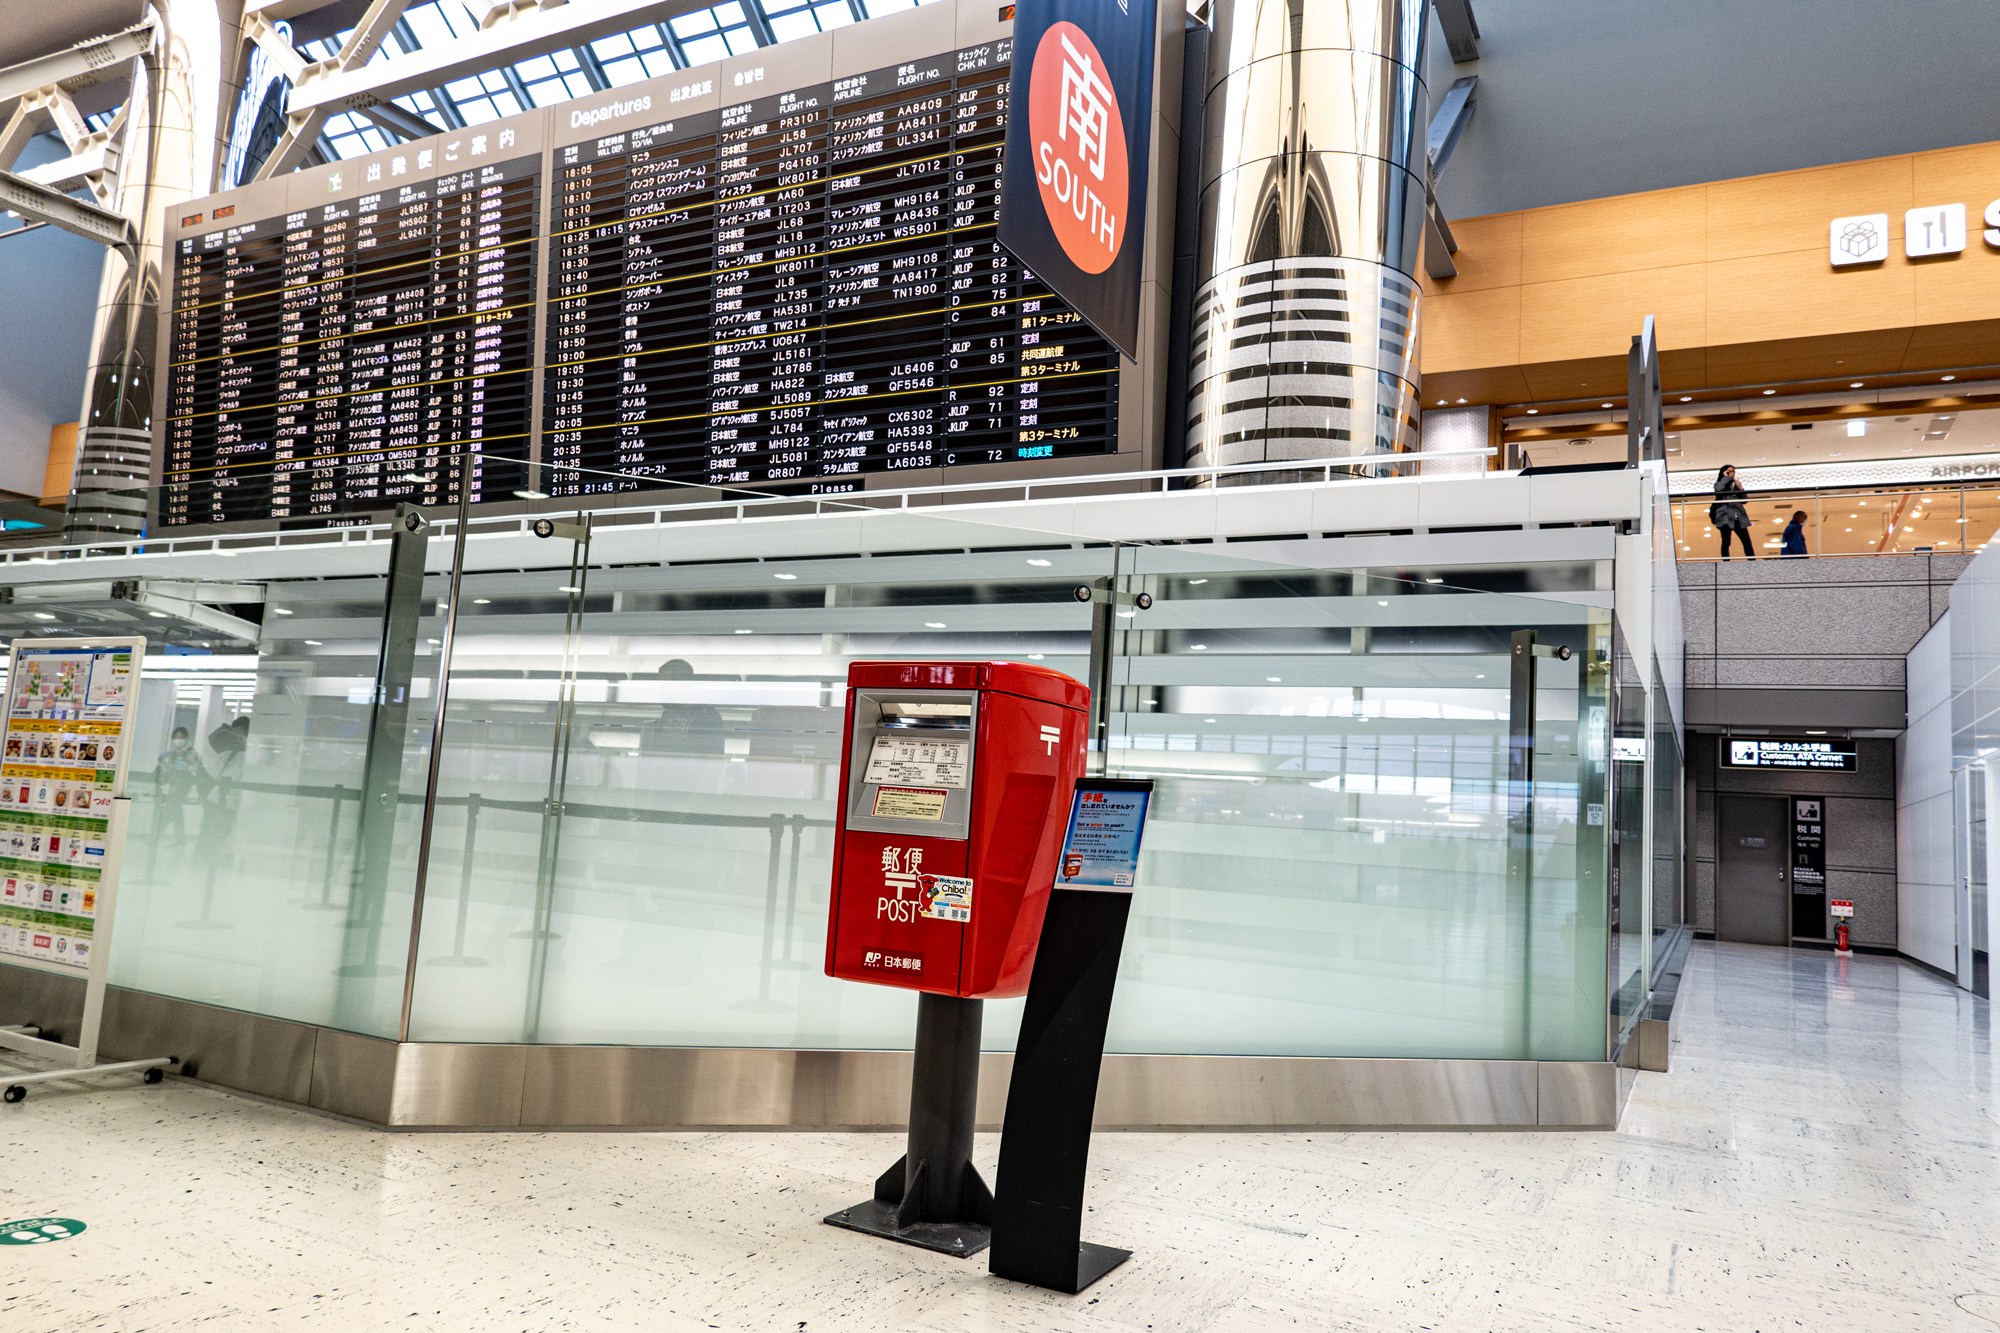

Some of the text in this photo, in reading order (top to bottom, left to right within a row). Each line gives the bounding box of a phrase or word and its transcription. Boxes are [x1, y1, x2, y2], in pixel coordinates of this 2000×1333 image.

[957, 46, 990, 62] チェックイン
[957, 57, 987, 72] CHK IN
[996, 51, 1012, 63] GAT
[897, 68, 941, 86] FLIGHT NO.
[898, 64, 915, 76] 便名
[834, 75, 867, 92] 航空会社
[834, 87, 862, 101] AIRLINE
[780, 93, 796, 105] 便名
[780, 98, 818, 114] FLIGHT NO.
[1059, 32, 1112, 181] 南
[571, 96, 651, 128] Departures
[722, 104, 752, 119] 航空会社
[722, 114, 748, 128] AIRLINE
[564, 98, 942, 192] 18:10 サンフランシスコ JL58 AA8409
[565, 112, 819, 179] 18:05 フィリピン航空 PR3101
[632, 137, 653, 149] TO/VIA
[779, 114, 940, 158] JL707 AA8411
[367, 128, 515, 182] 出発便ご案内
[564, 155, 578, 165] TIME
[597, 145, 624, 157] WILL DEP.
[778, 129, 940, 172] PG4160 UL3341
[461, 180, 474, 189] GATE
[480, 172, 504, 184] REMARKS
[778, 170, 819, 187] UK8012
[628, 160, 941, 232] ダラスフォートワース アメリカン航空 AA60 JL7012
[1038, 141, 1115, 253] SOUTH
[399, 203, 429, 217] JL9567
[323, 215, 428, 245] NX861 ANA NH5902
[398, 228, 426, 241] JL9241
[561, 191, 940, 271] 18:30 日本航空 JL68 MH9164
[562, 201, 811, 257] 18:25 タイガーエア台湾 IT203
[776, 206, 939, 245] JL18 AA8436
[717, 222, 937, 269] マレーシア航空 MH9112 WS5901
[322, 257, 344, 268] HB531
[775, 253, 938, 289] JL8 MH9108
[626, 259, 814, 300] シンガポール UK8011
[320, 292, 343, 303] VJ935
[394, 301, 424, 313] MH9114
[559, 268, 938, 336] 18:50 JL735 AA8417
[714, 284, 937, 326] ハワイアン航空 HA5381 TN1900
[318, 313, 424, 338] CI105 JL5175
[558, 289, 1007, 362] 19:00 ティーウェイ航空 TW214 75
[772, 301, 1041, 347] UO647 定刻
[318, 338, 422, 362] JL759 AA8422
[557, 311, 1082, 390] 19:30 JL5161 第1ターミナル
[391, 375, 420, 386] GA9151
[555, 405, 583, 416] 19:55
[770, 378, 805, 391] HA822
[890, 362, 935, 376] JL6406
[622, 362, 812, 395] ホノルル JL8786
[771, 361, 1081, 405] JL5089 QF5546 第3ターミナル
[390, 400, 420, 411] AA8482
[554, 407, 811, 444] 20:35 5J5057
[770, 409, 933, 435] JL784 CX6302
[313, 434, 337, 444] JL717
[768, 425, 933, 450] MH9122 HA5393
[769, 440, 933, 464] JL5081 QF5548
[619, 446, 1054, 491] ドーハ カタール航空 QR807 LA6035 72 時刻変更
[811, 484, 854, 494] Please
[1760, 752, 1796, 760] Customs,
[1797, 753, 1815, 761] ATA
[881, 846, 923, 875] 郵便
[940, 877, 965, 885] Welcome
[941, 884, 967, 894] Chiba!
[877, 897, 920, 924] POST
[884, 955, 921, 971] 日本郵便
